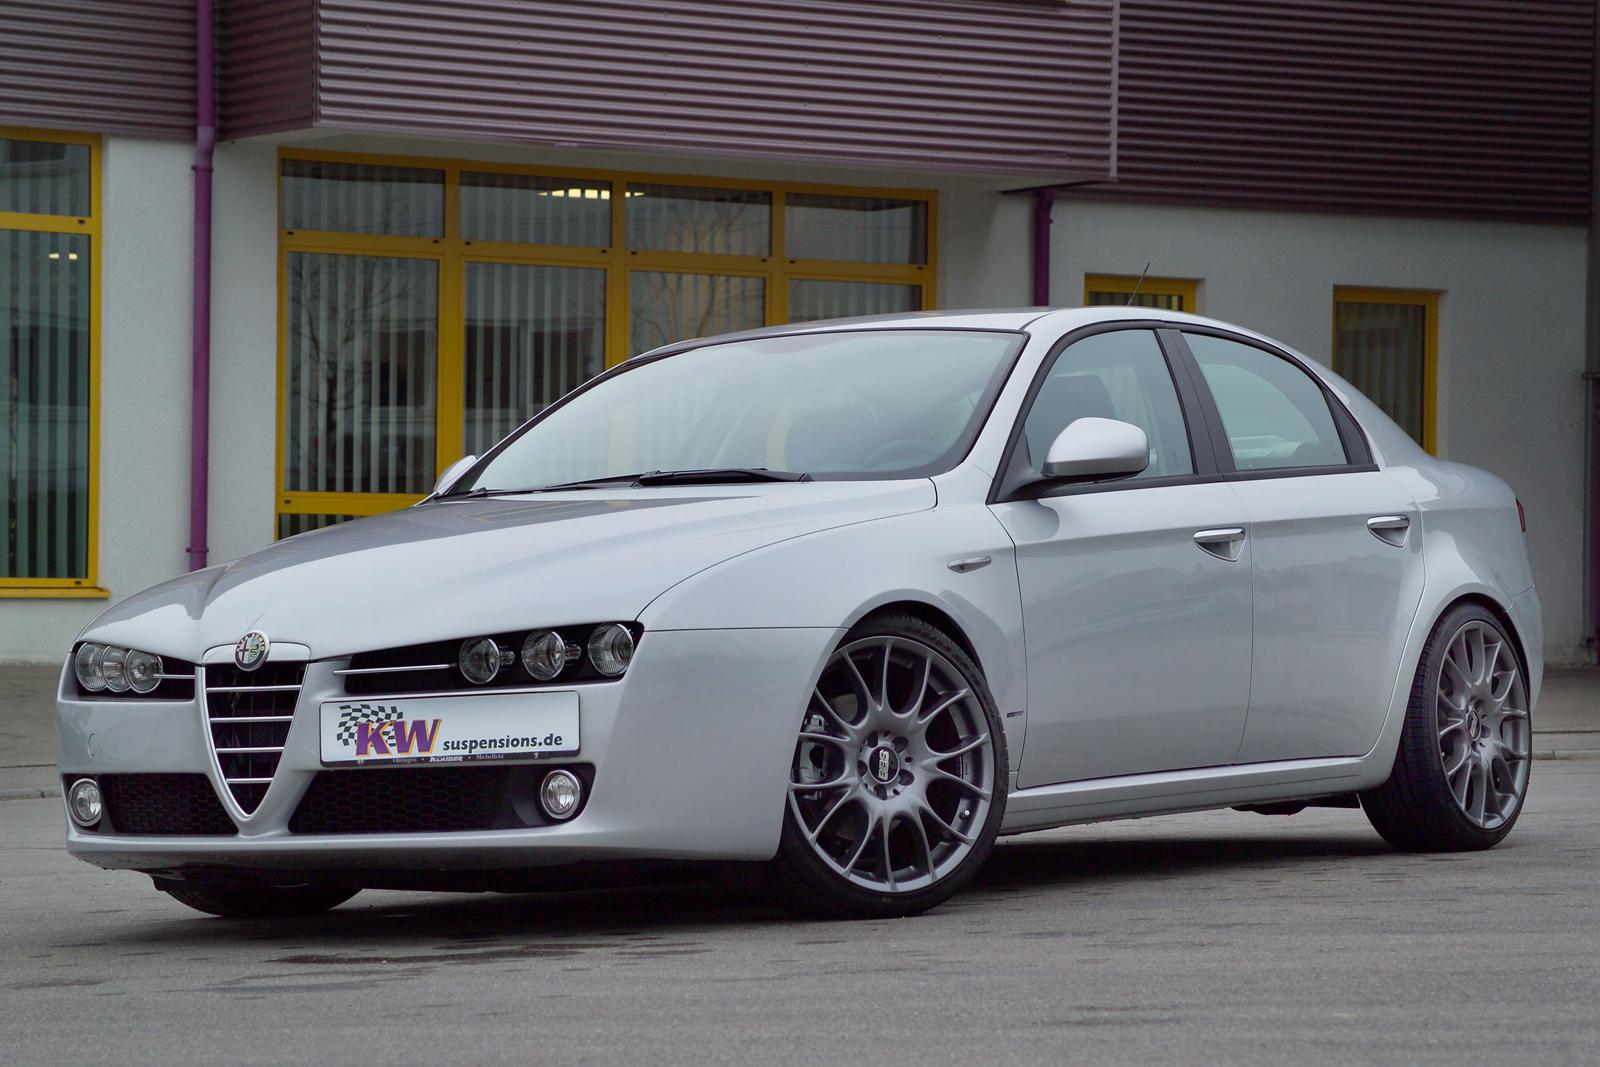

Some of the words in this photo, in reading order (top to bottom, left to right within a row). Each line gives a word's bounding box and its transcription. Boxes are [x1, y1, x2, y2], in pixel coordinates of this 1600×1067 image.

[355, 719, 442, 757] KW
[443, 733, 563, 754] suspensions.de
[879, 749, 889, 780] BBS
